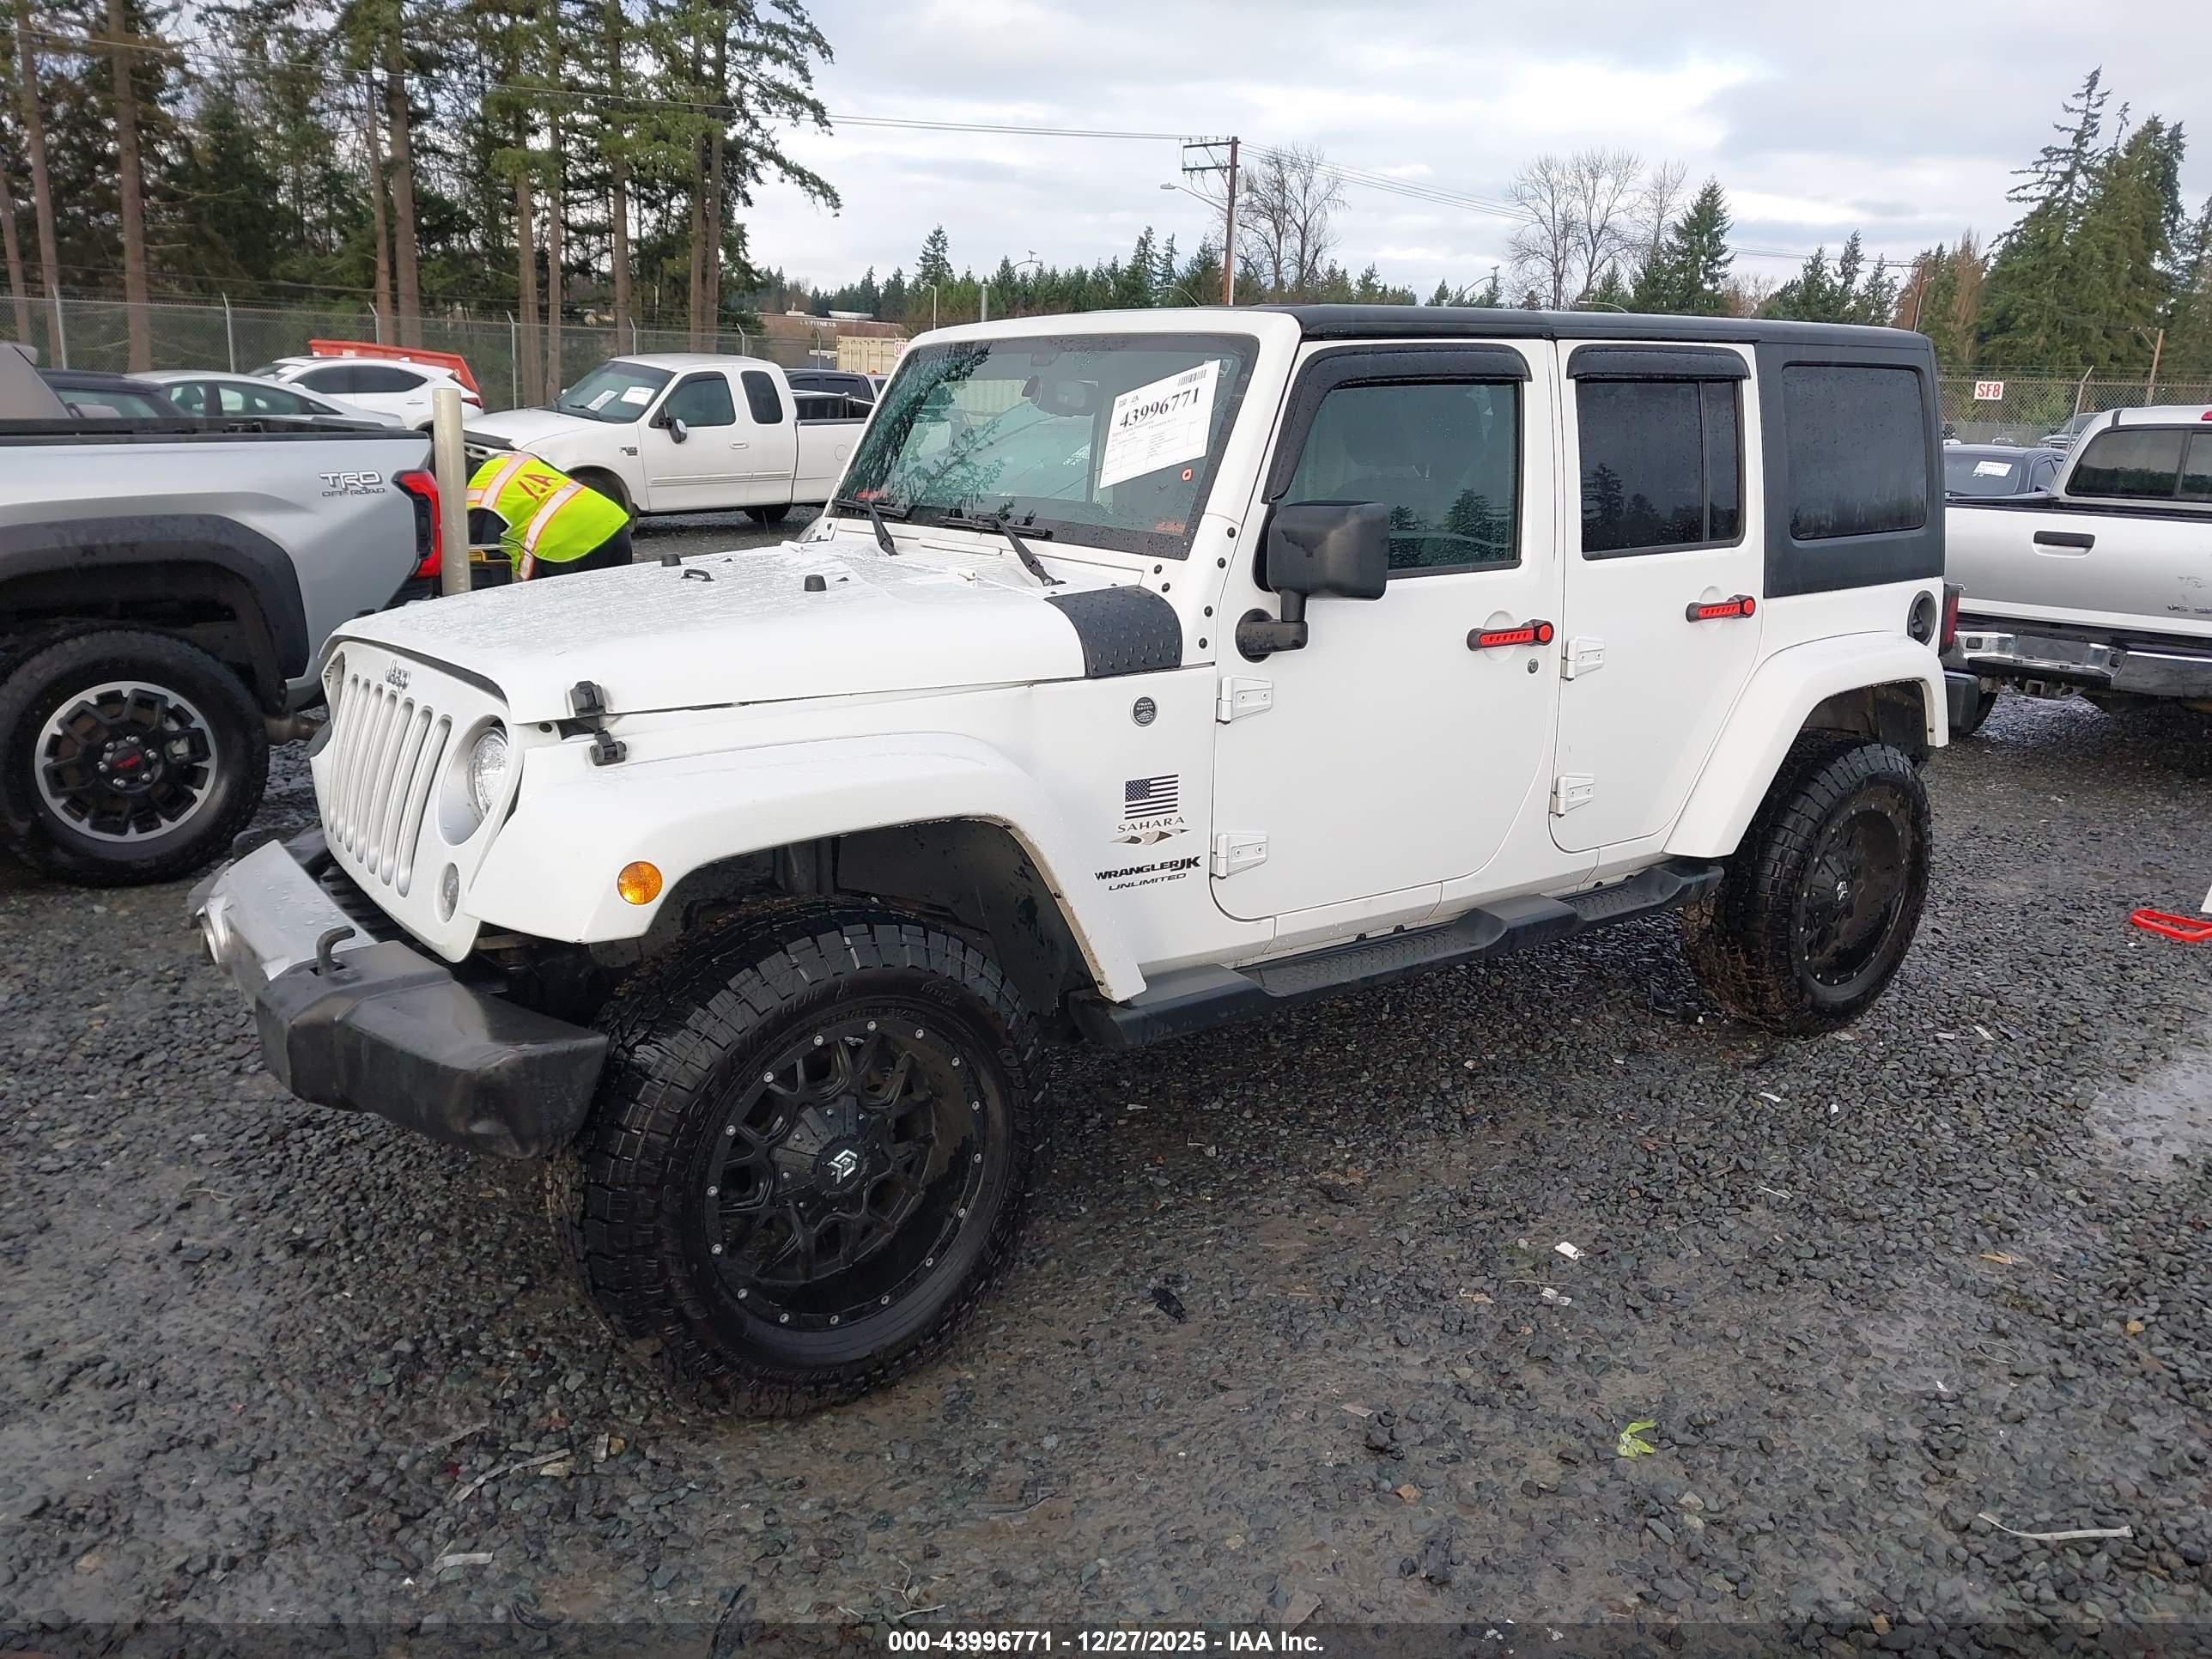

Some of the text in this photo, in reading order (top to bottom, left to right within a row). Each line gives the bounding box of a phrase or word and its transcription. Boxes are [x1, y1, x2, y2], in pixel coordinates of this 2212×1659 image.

[1978, 383, 2001, 398] SF8
[1119, 386, 1199, 428] 43996771
[319, 471, 383, 490] TRD
[1117, 817, 1185, 834] SAHARA
[1108, 873, 1187, 891] UNLIMITED
